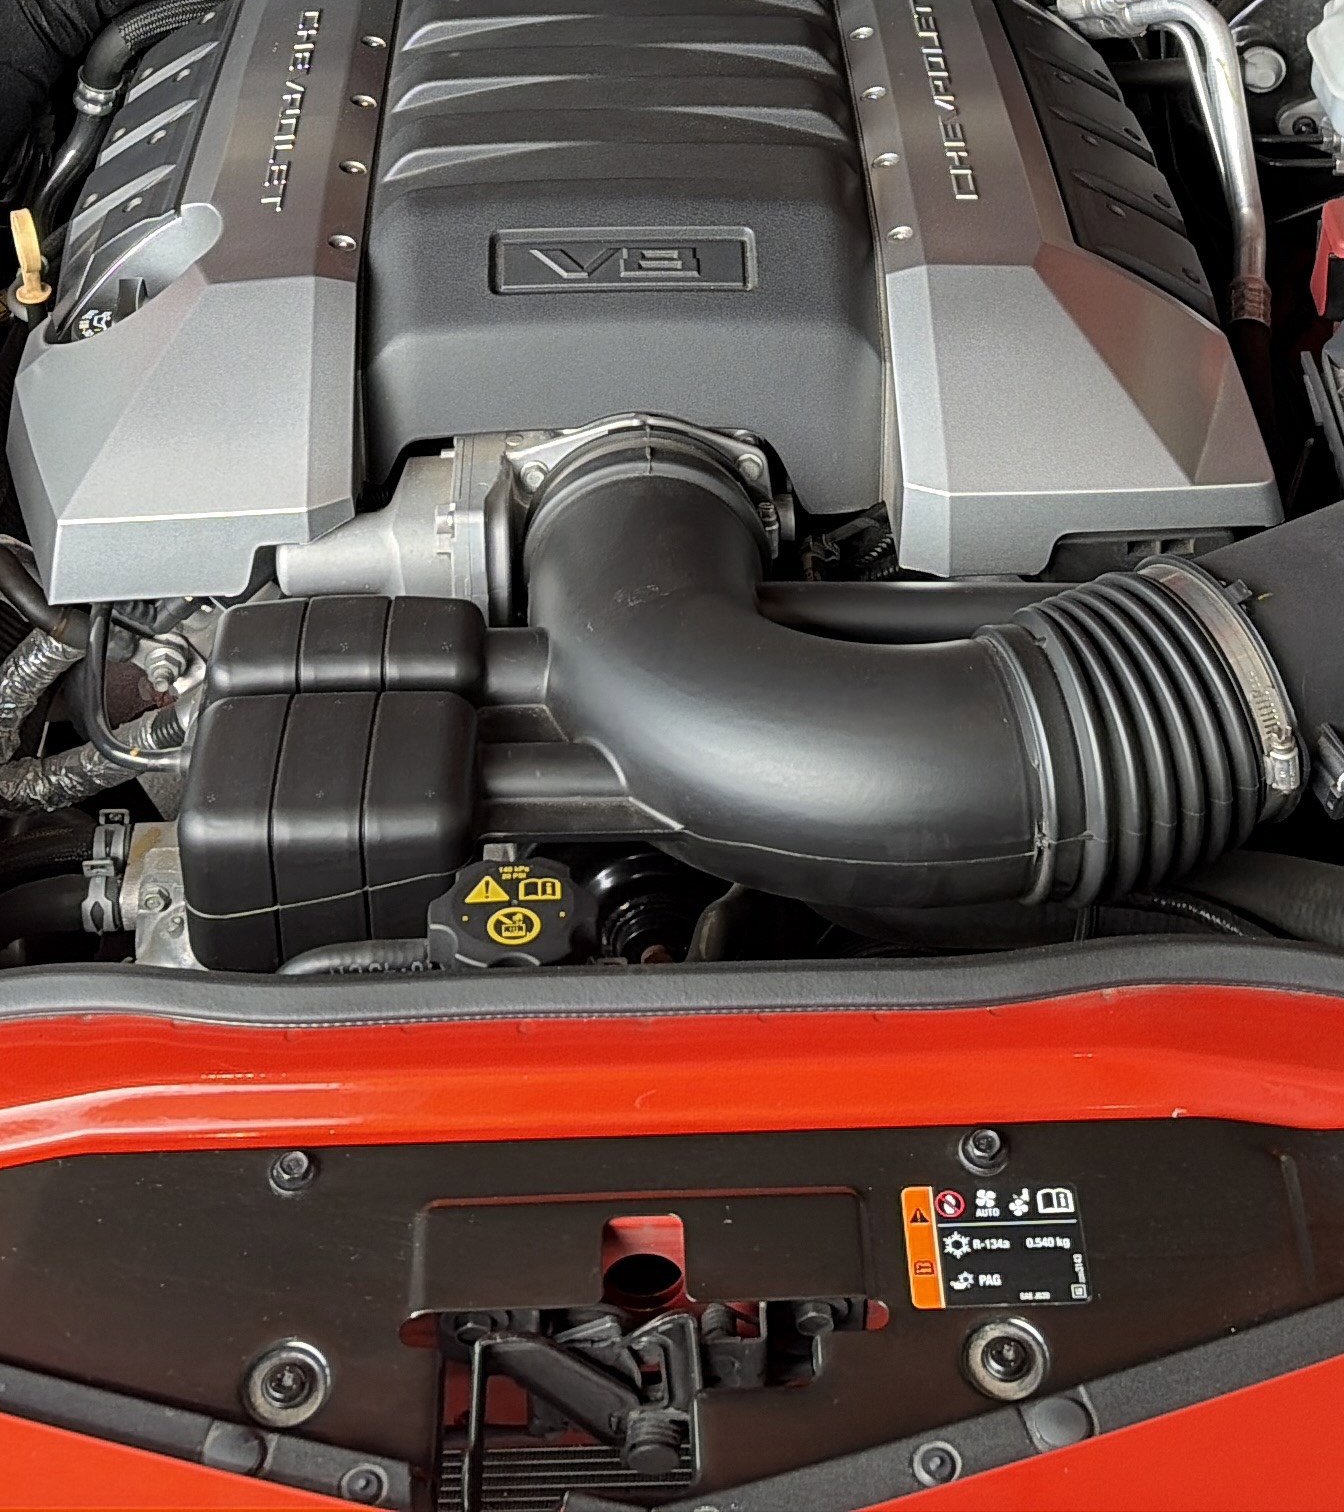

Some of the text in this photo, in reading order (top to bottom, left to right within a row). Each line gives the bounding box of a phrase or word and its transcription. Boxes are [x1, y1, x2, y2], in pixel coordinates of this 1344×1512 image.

[260, 9, 322, 212] CHEVROLET
[528, 246, 700, 279] V8
[975, 1207, 1000, 1217] AUTO
[972, 1238, 1011, 1250] R-134a
[1055, 1236, 1071, 1250] kg
[978, 1273, 1003, 1287] PAG
